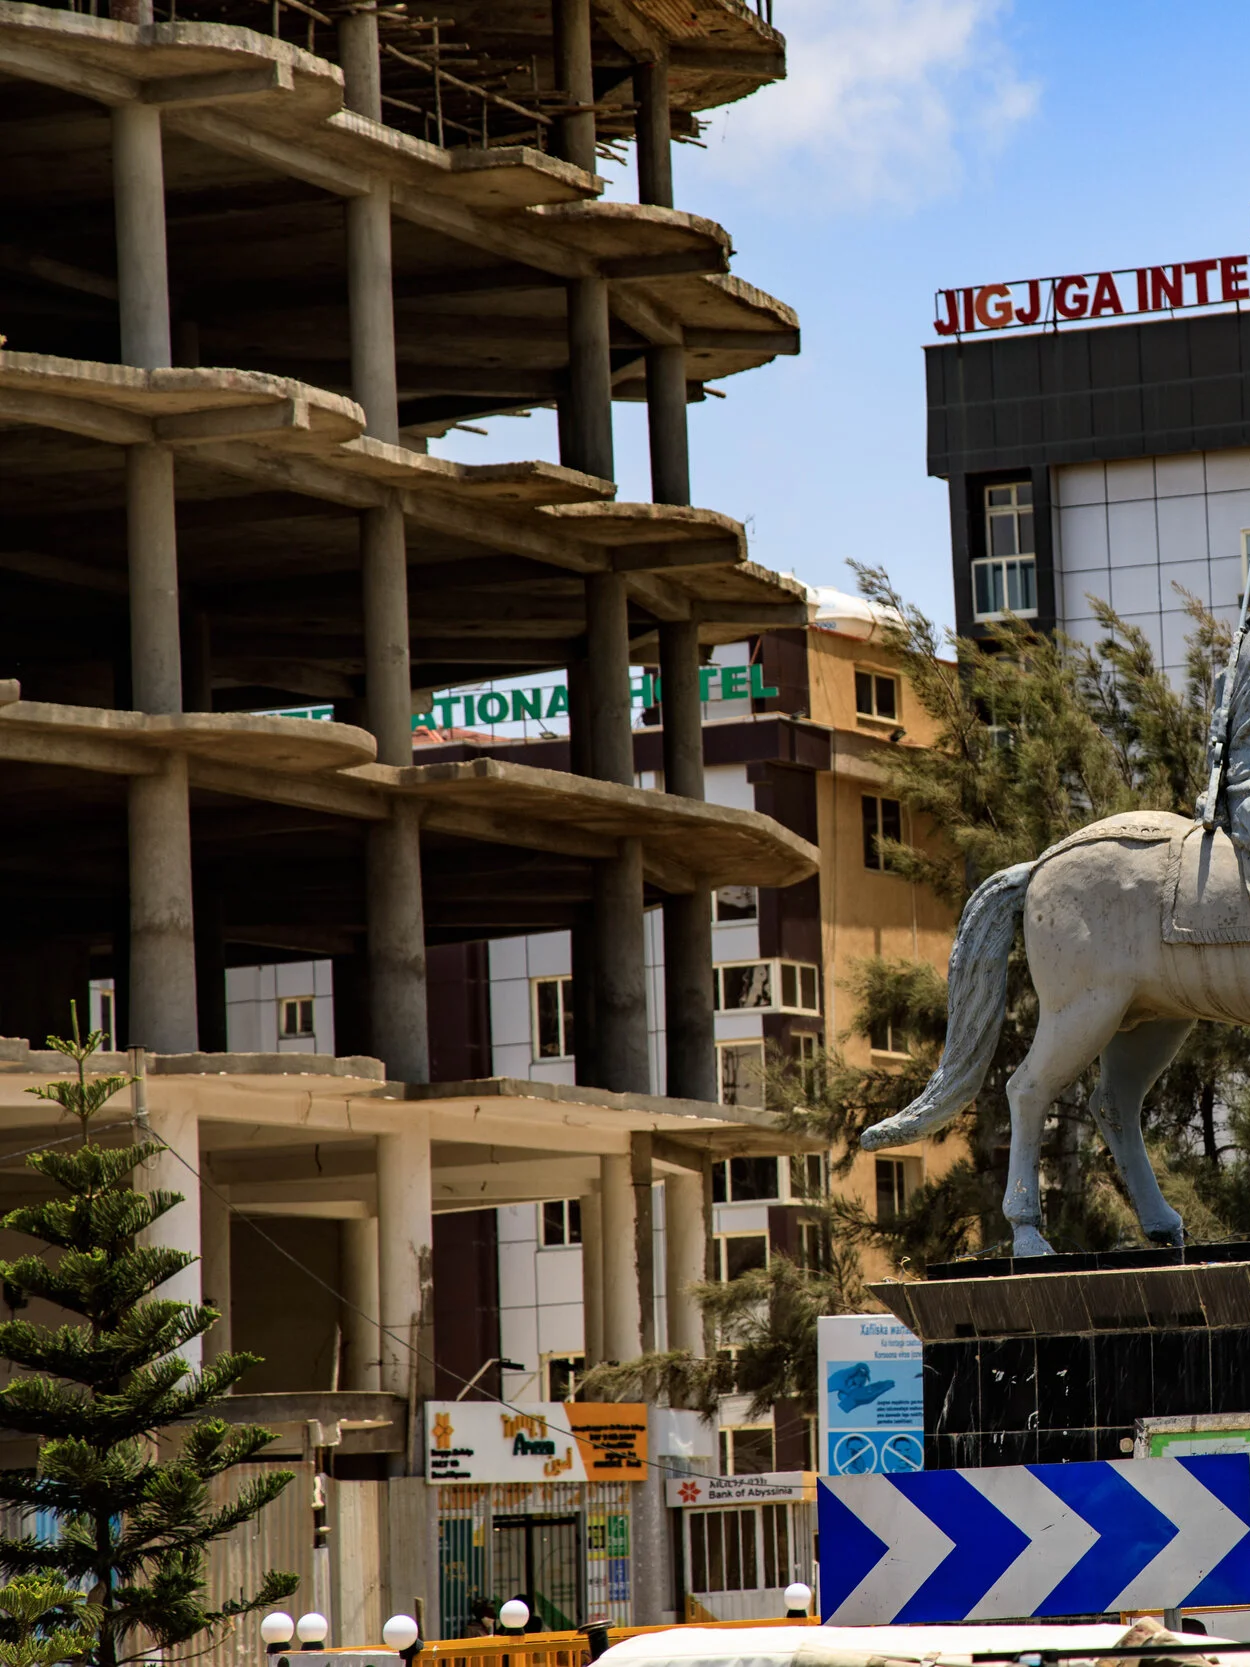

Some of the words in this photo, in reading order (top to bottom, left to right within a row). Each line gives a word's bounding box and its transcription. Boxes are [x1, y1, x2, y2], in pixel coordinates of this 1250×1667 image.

[630, 663, 780, 709] HTEL
[708, 1489, 733, 1499] Bank
[735, 1488, 745, 1498] of
[748, 1487, 793, 1498] Abyssinia
